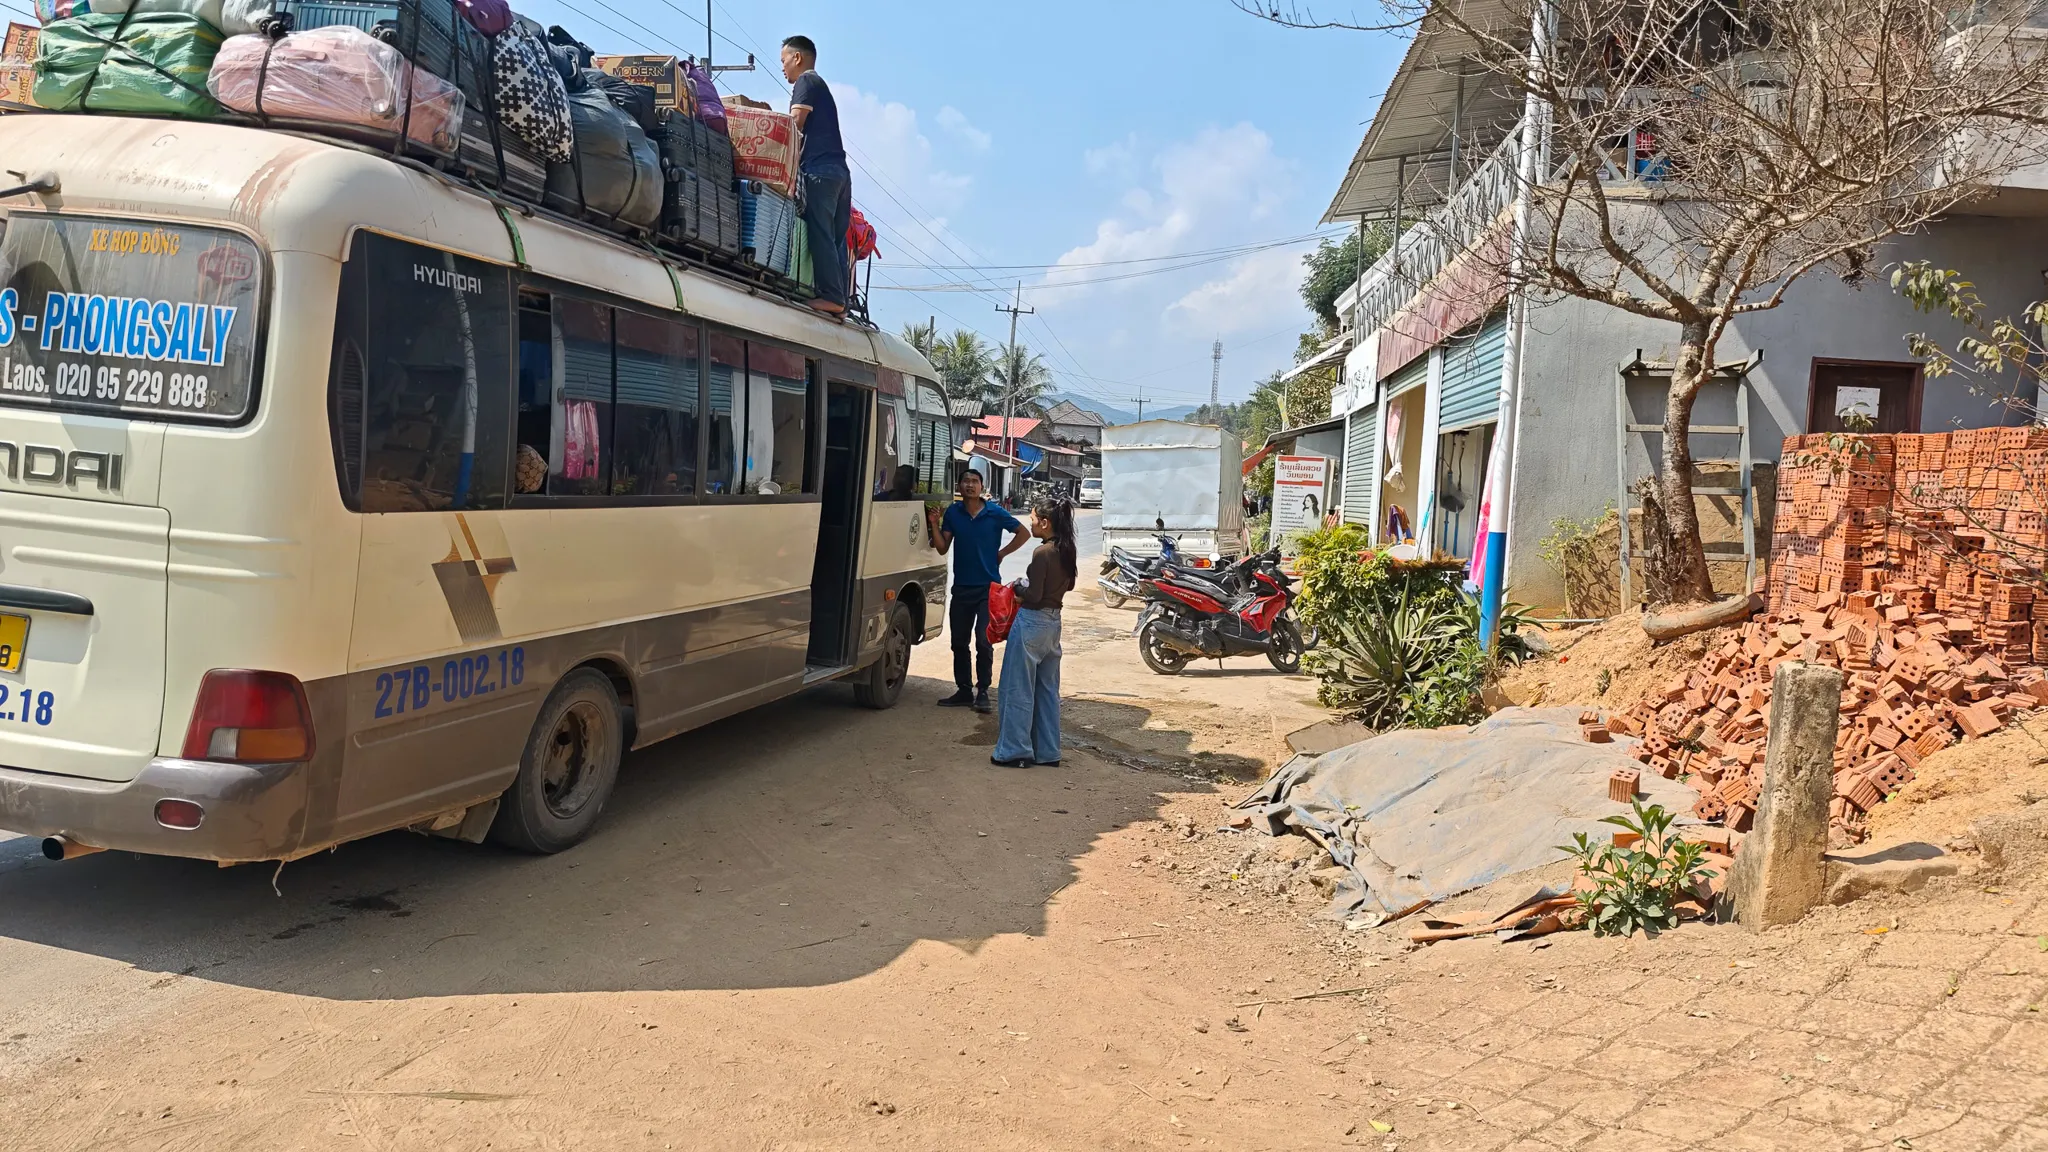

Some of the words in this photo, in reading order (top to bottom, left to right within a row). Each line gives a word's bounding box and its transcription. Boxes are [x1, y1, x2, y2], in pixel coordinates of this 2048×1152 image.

[10, 29, 29, 82] MDERN
[612, 65, 665, 77] MODERN
[89, 229, 110, 251] XE
[110, 229, 138, 257] HỢP
[140, 227, 181, 257] ĐỒNG
[413, 263, 482, 295] HYUNDAI
[40, 290, 238, 367] PHONGSALY
[2, 357, 50, 393] Laos.
[55, 362, 92, 398] 020
[96, 366, 121, 400] 95
[124, 368, 163, 404] 229
[167, 372, 208, 409] 888
[374, 646, 525, 719] 27B-002.18
